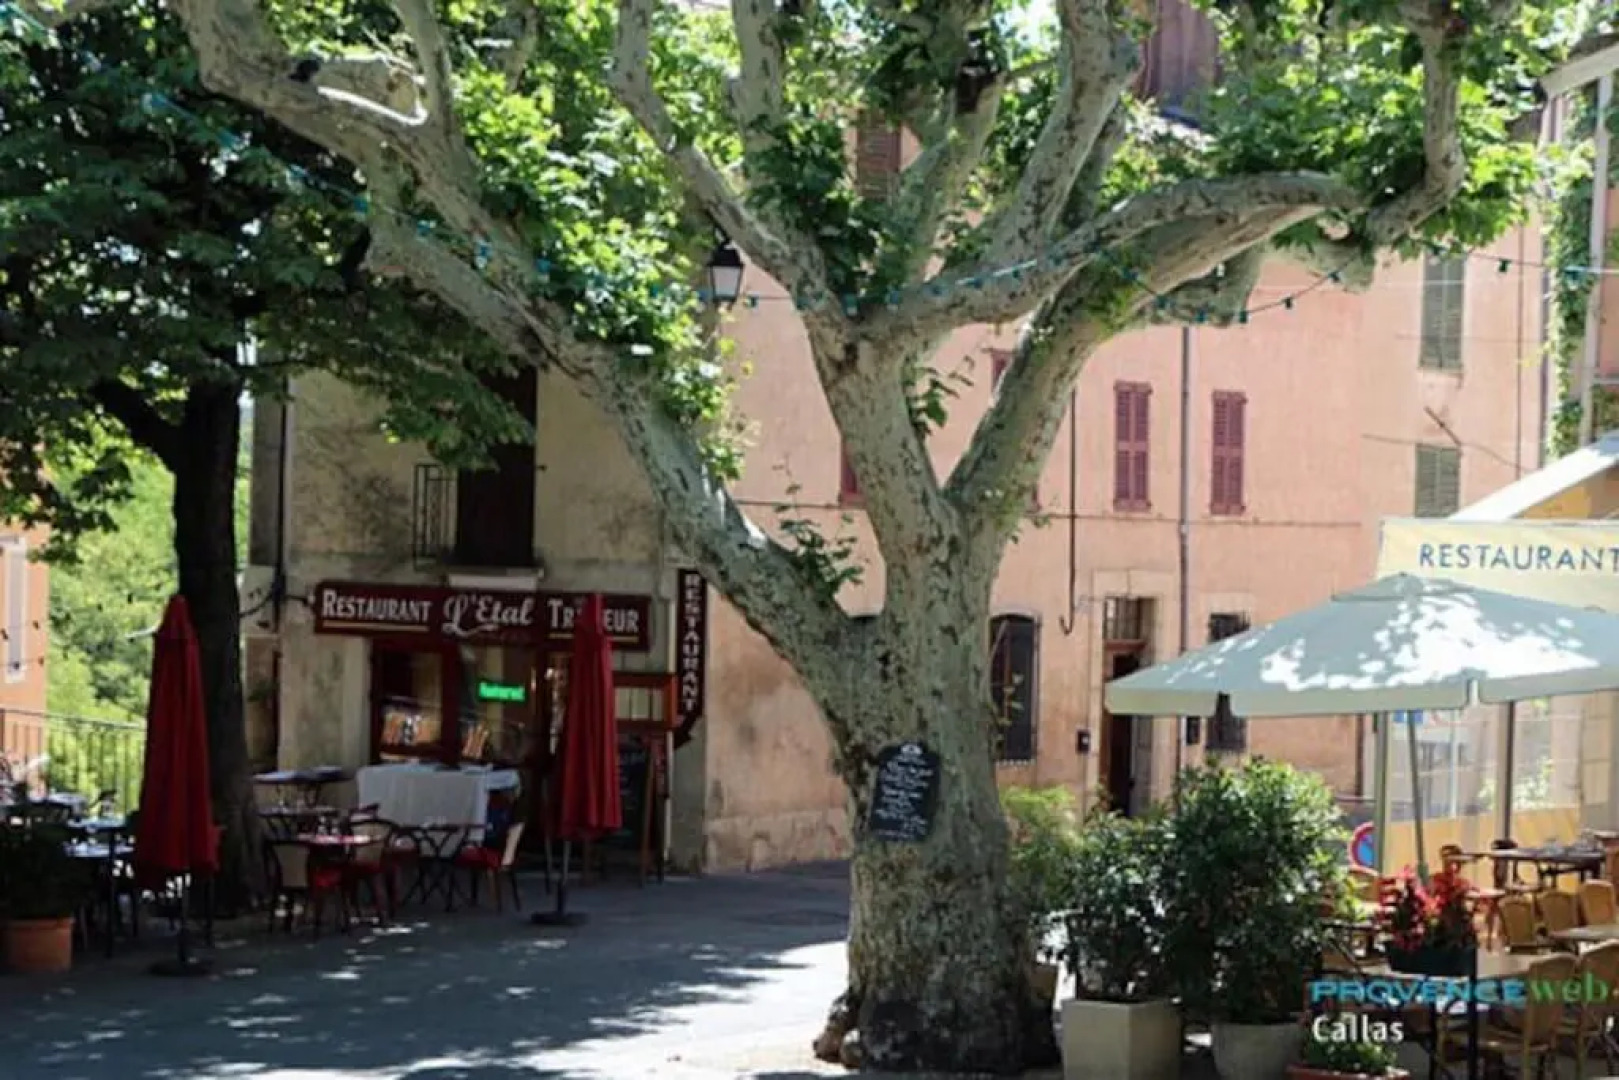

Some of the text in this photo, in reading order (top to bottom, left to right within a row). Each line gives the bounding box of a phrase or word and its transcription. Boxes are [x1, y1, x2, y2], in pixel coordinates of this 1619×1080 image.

[1419, 543, 1619, 571] RESTAURANT
[547, 599, 639, 632] TREUR
[683, 573, 699, 711] RESTAURANT
